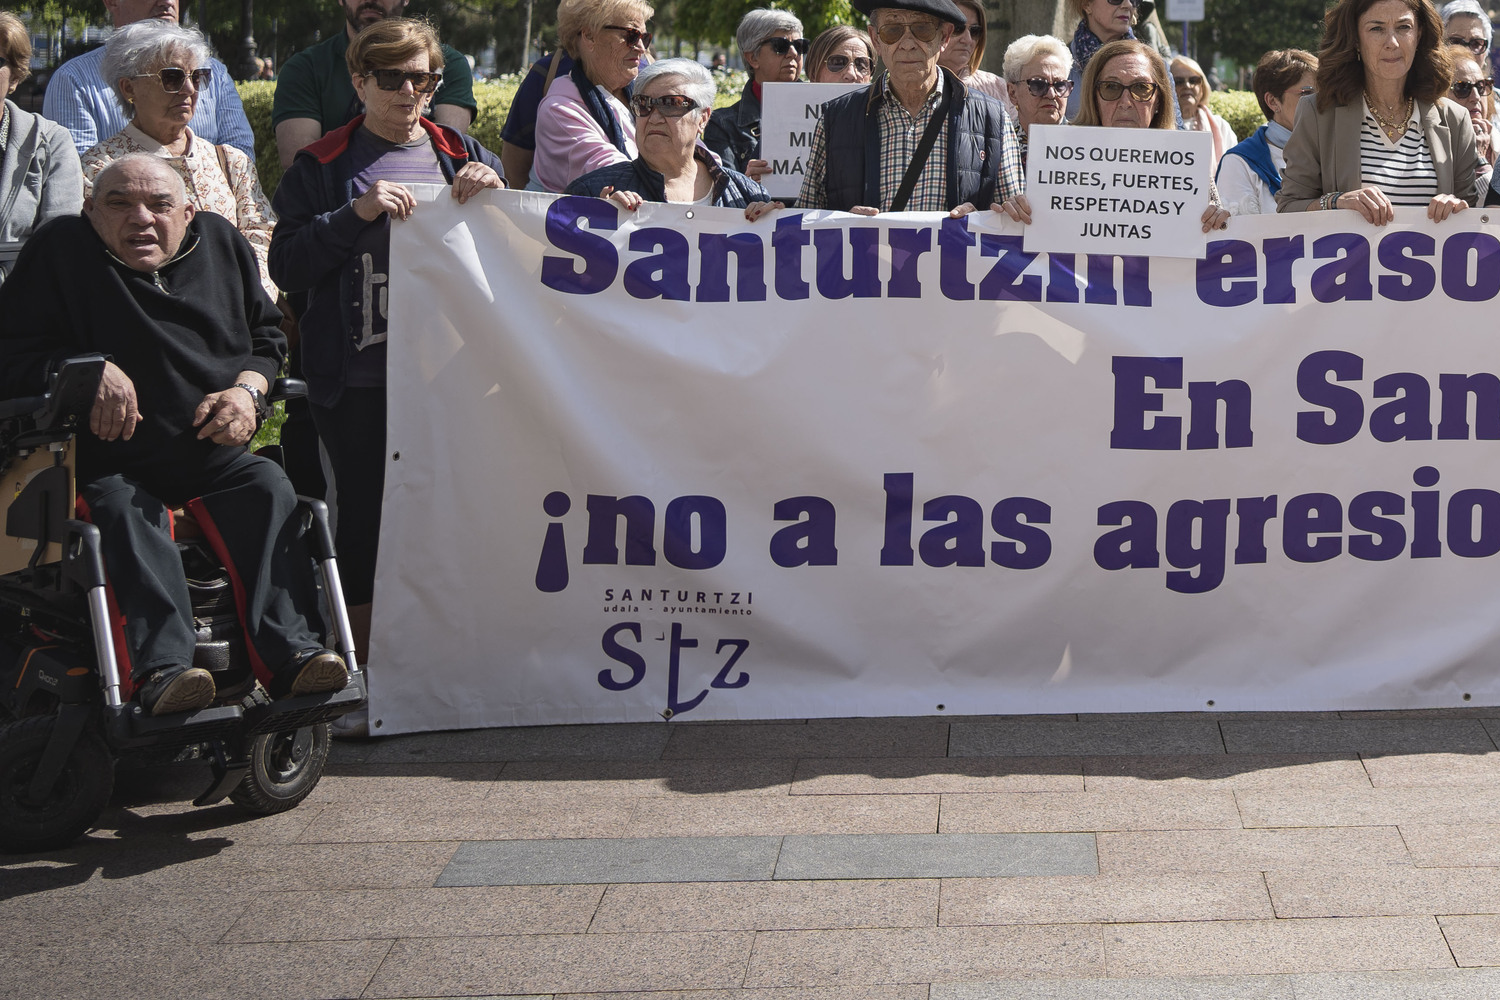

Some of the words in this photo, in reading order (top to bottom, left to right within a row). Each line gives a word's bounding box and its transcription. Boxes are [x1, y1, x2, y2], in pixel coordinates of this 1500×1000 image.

[772, 156, 811, 175] MÁ
[1045, 145, 1085, 161] NOS
[1089, 147, 1195, 166] QUEREMOS
[1038, 170, 1106, 191] LIBRES,
[1112, 173, 1199, 195] FUERTES,
[1050, 195, 1170, 215] RESPETADAS
[1172, 201, 1185, 216] Y
[1080, 222, 1152, 239] JUNTAS
[1110, 355, 1254, 451] En
[535, 490, 728, 593] ¡no
[769, 495, 839, 568] a
[880, 471, 1053, 571] las
[603, 588, 753, 605] SANTURTZI
[603, 604, 640, 614] udala
[663, 605, 753, 616] ayuntamiento
